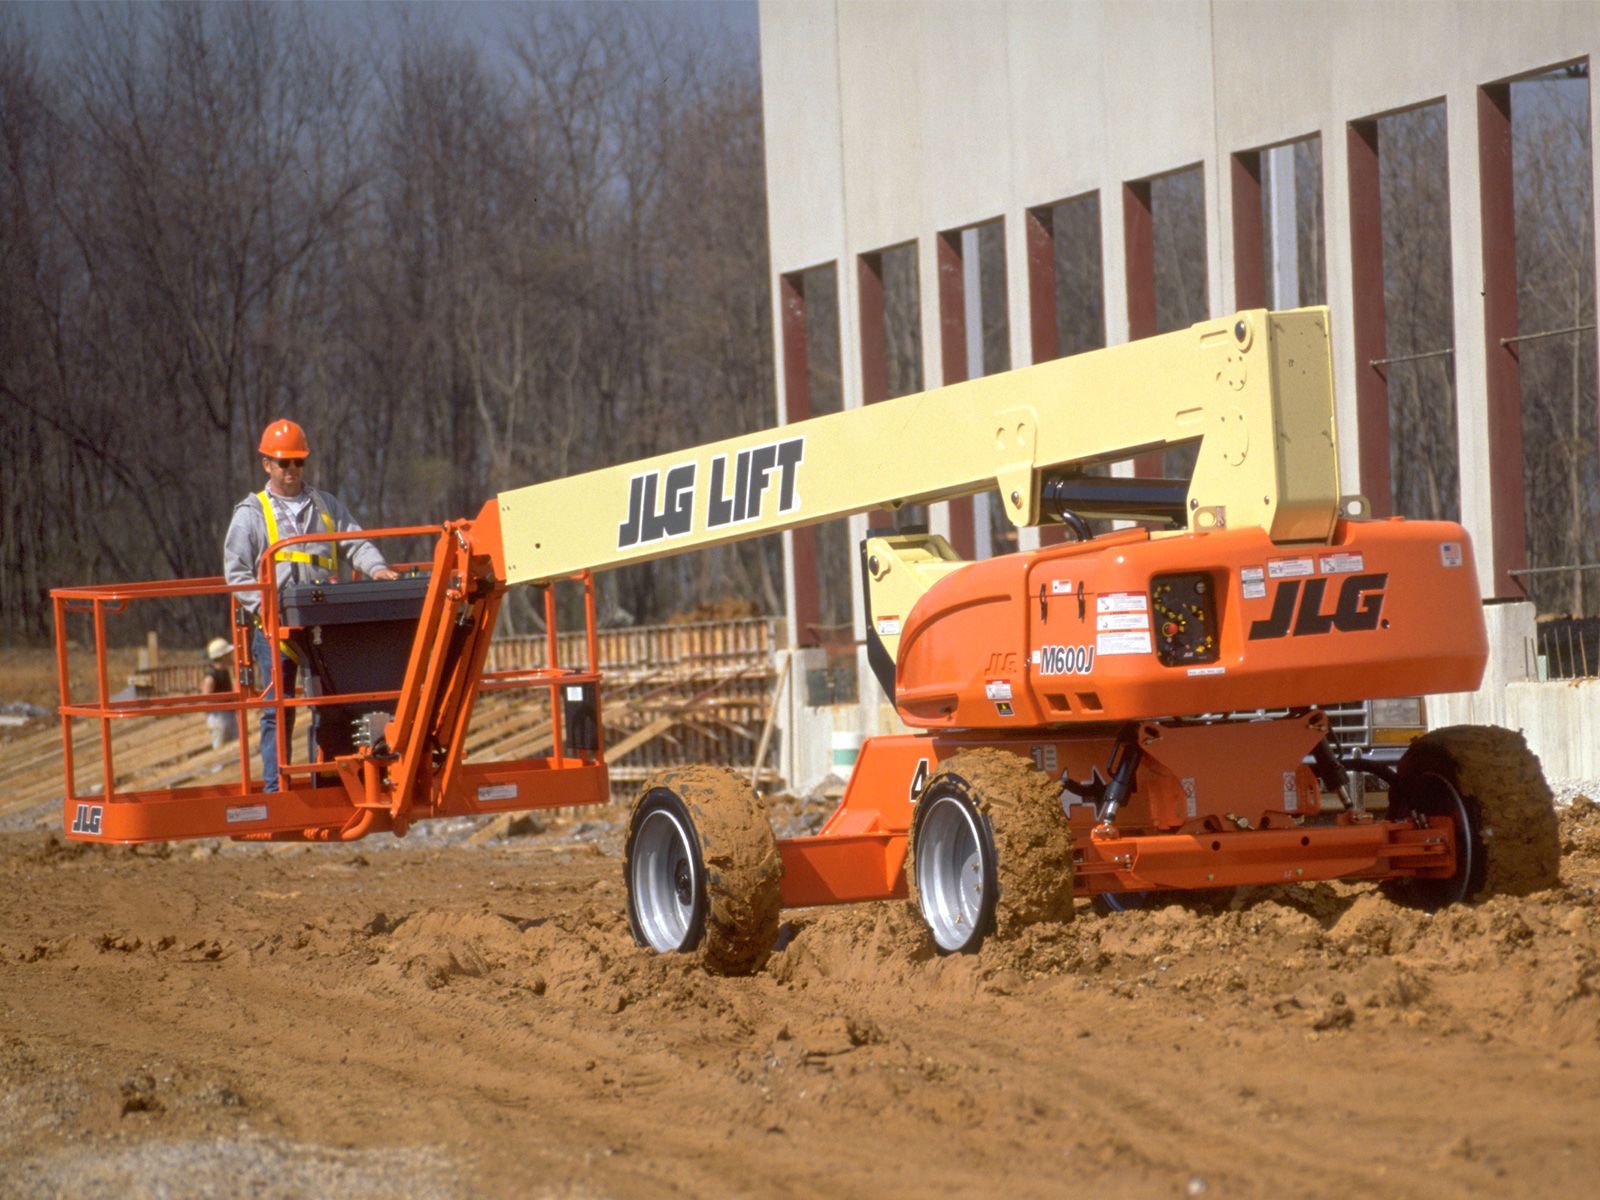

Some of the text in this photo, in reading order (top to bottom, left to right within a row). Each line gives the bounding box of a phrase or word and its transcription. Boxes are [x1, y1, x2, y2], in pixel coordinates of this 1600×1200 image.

[618, 437, 804, 549] JLG LIFT
[1040, 646, 1094, 674] M600J
[72, 804, 102, 834] JLG
